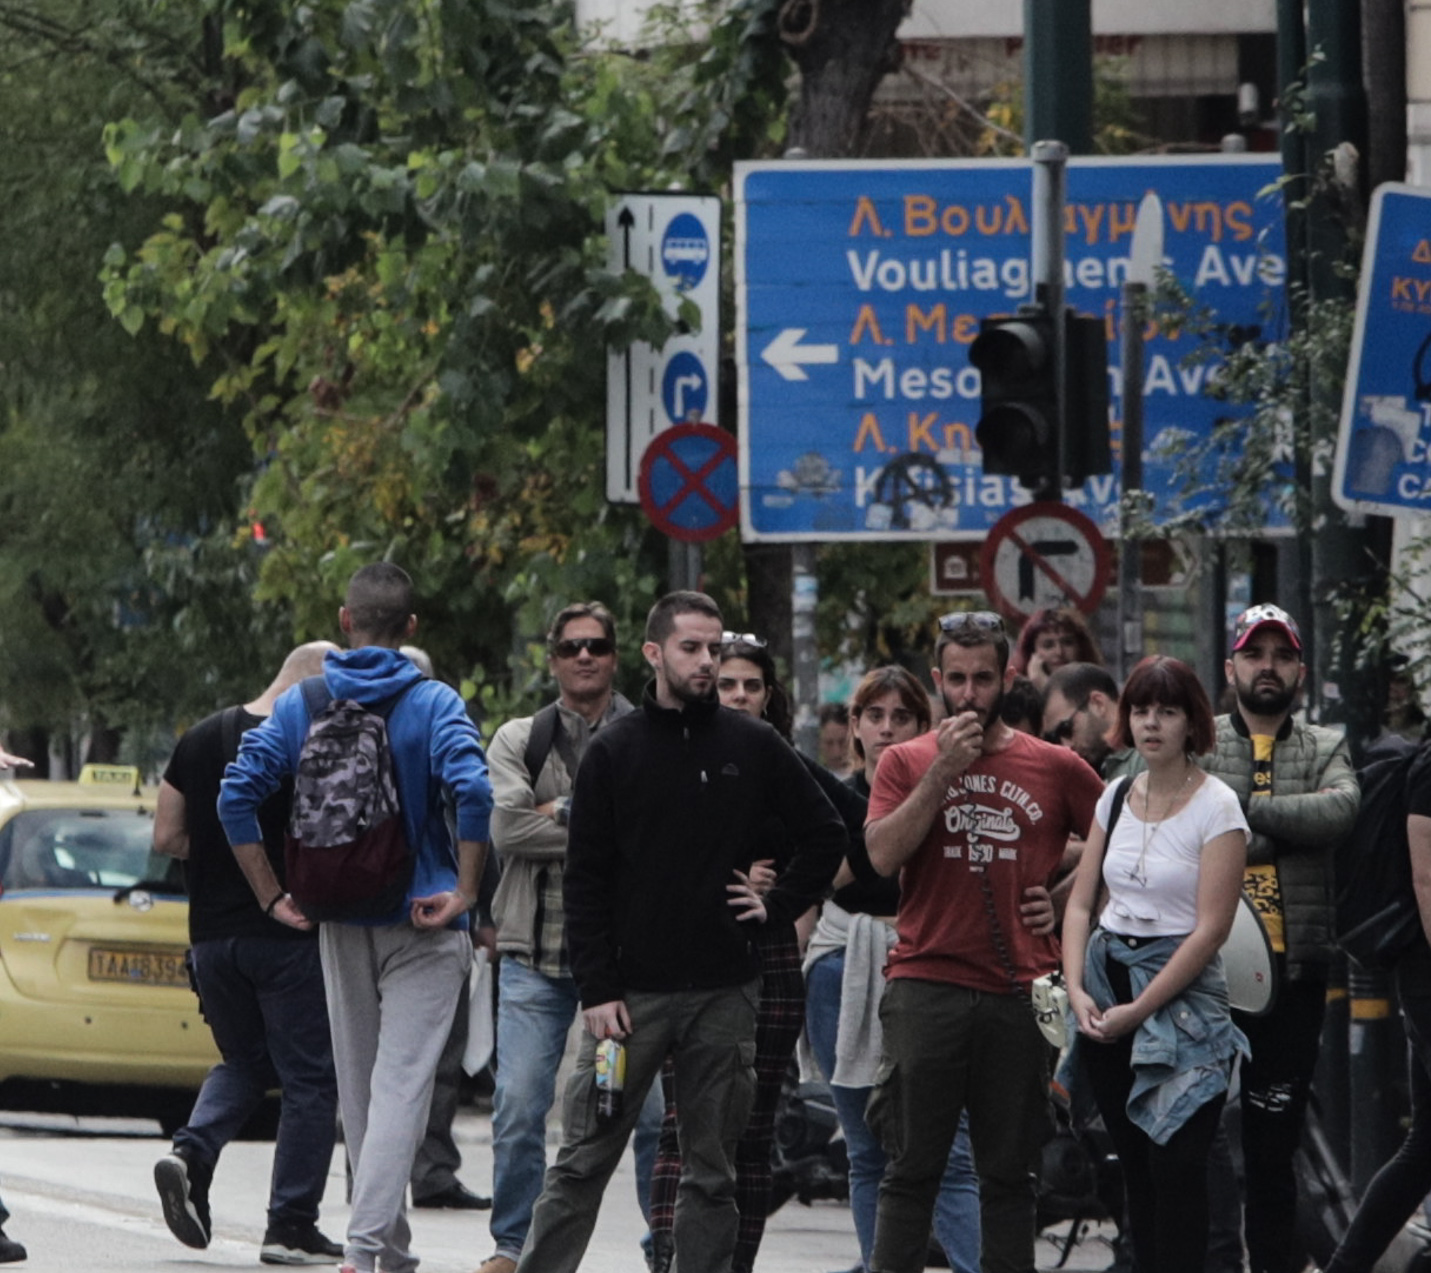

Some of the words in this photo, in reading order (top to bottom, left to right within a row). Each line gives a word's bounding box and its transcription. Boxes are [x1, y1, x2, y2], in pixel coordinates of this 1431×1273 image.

[847, 194, 893, 237] Λ.
[903, 193, 1254, 244] Βουλγμνης
[849, 303, 893, 347] Λ.
[852, 412, 898, 455] Λ.
